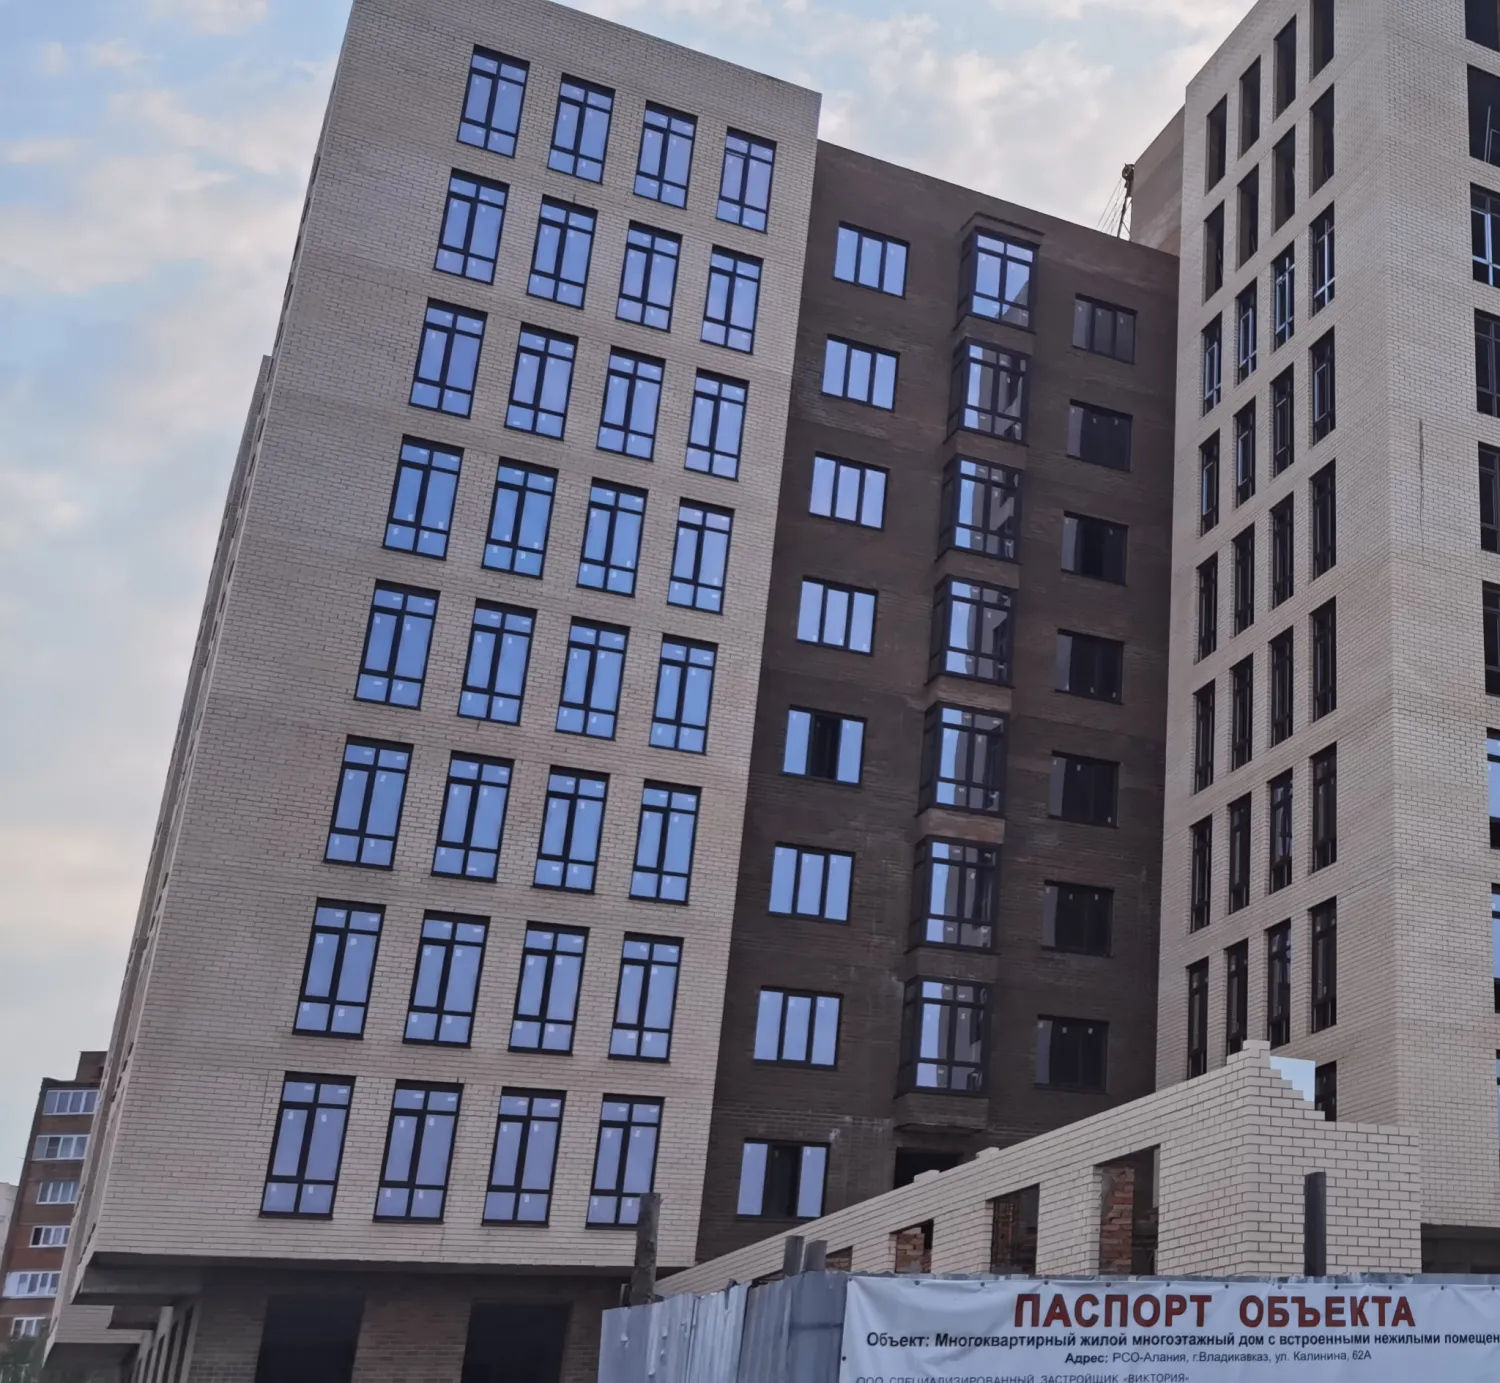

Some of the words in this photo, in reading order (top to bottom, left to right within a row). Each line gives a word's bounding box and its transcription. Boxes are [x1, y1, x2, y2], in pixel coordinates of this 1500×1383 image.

[1014, 1293, 1212, 1328] ПАСПОРТ
[1239, 1295, 1416, 1328] ОБЪЕКТА
[866, 1332, 930, 1347] Объект:
[935, 1332, 1076, 1349] Многоквартирный
[1080, 1332, 1127, 1346] жилой
[1132, 1332, 1235, 1346] многоэтажный
[1238, 1334, 1264, 1347] дом
[1268, 1335, 1276, 1345] с
[1279, 1333, 1370, 1347] встроенными
[1374, 1332, 1440, 1345] нежилыми
[1064, 1352, 1109, 1365] Адрес:
[1112, 1352, 1189, 1364] РСО-Алания,
[1275, 1353, 1290, 1364] ул.
[1293, 1350, 1349, 1362] Калинина,
[1352, 1350, 1372, 1361] 62А
[1040, 1373, 1119, 1383] ЗАСТРОЙЩИК
